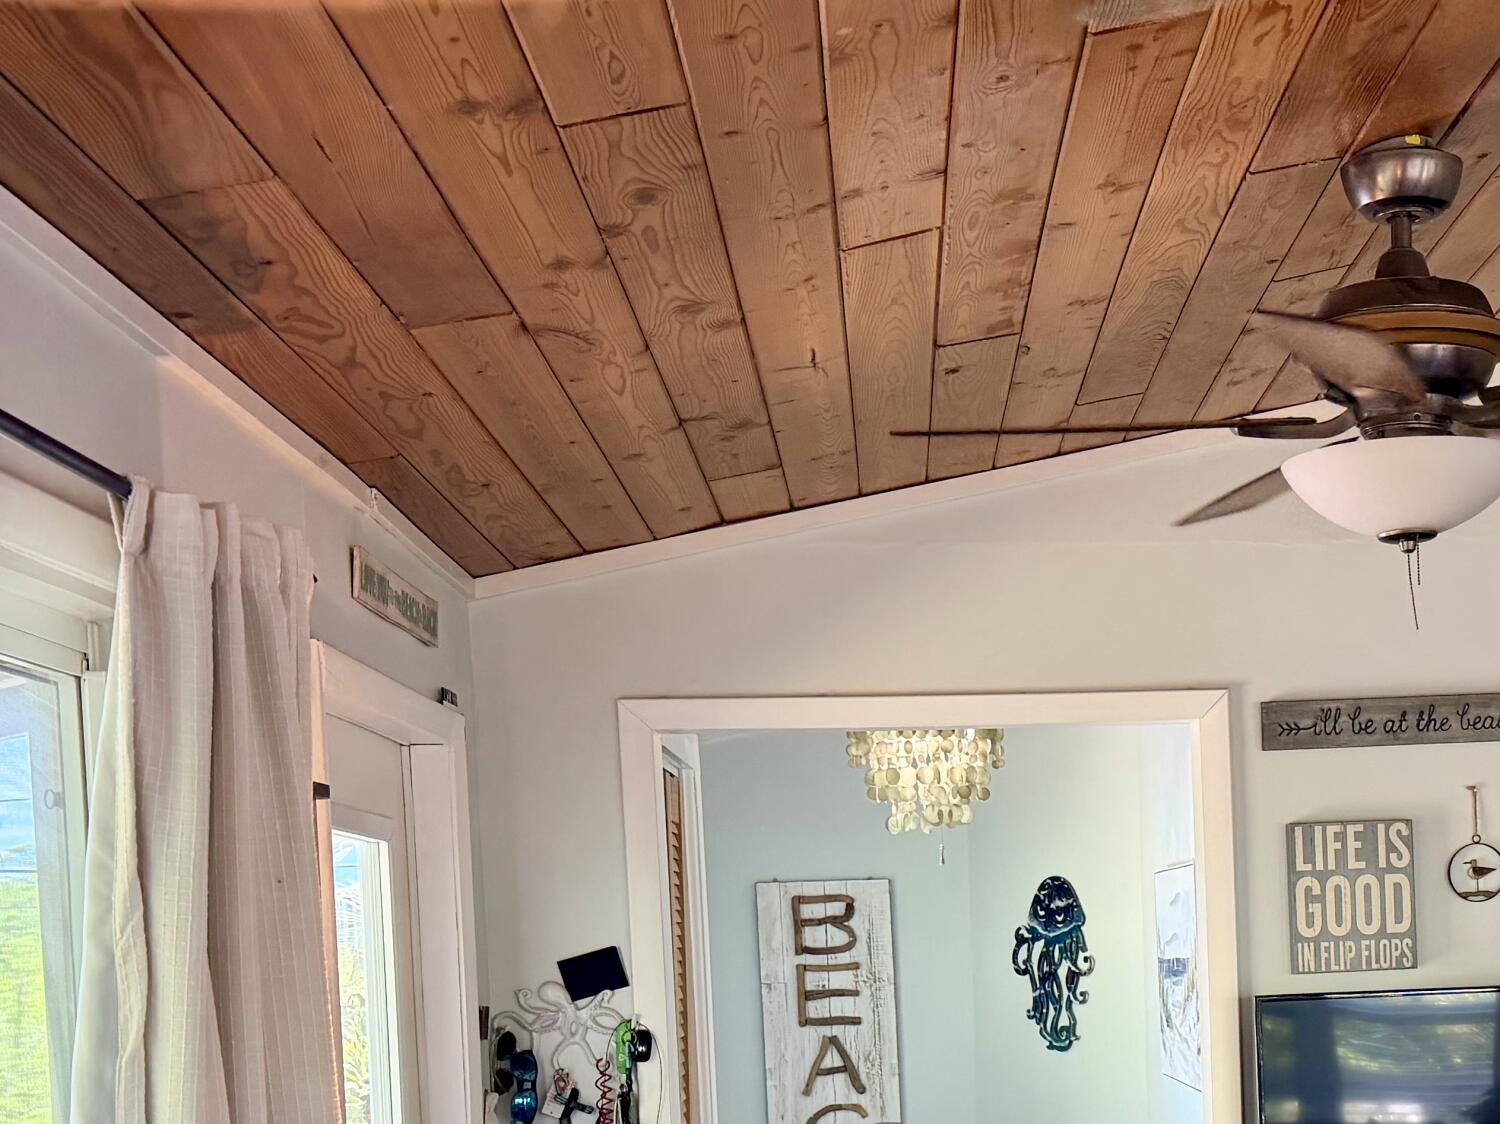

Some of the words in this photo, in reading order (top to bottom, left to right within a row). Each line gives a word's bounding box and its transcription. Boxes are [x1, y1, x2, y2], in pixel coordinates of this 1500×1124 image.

[1348, 705, 1377, 735] be
[1383, 710, 1408, 734] at
[1415, 704, 1451, 732] the
[1294, 823, 1366, 872] LIFE
[1377, 822, 1411, 869] IS
[1295, 873, 1412, 938] GOOD
[1297, 942, 1316, 972] IN
[1320, 940, 1356, 971] FLIP
[1360, 937, 1413, 969] FLOPS
